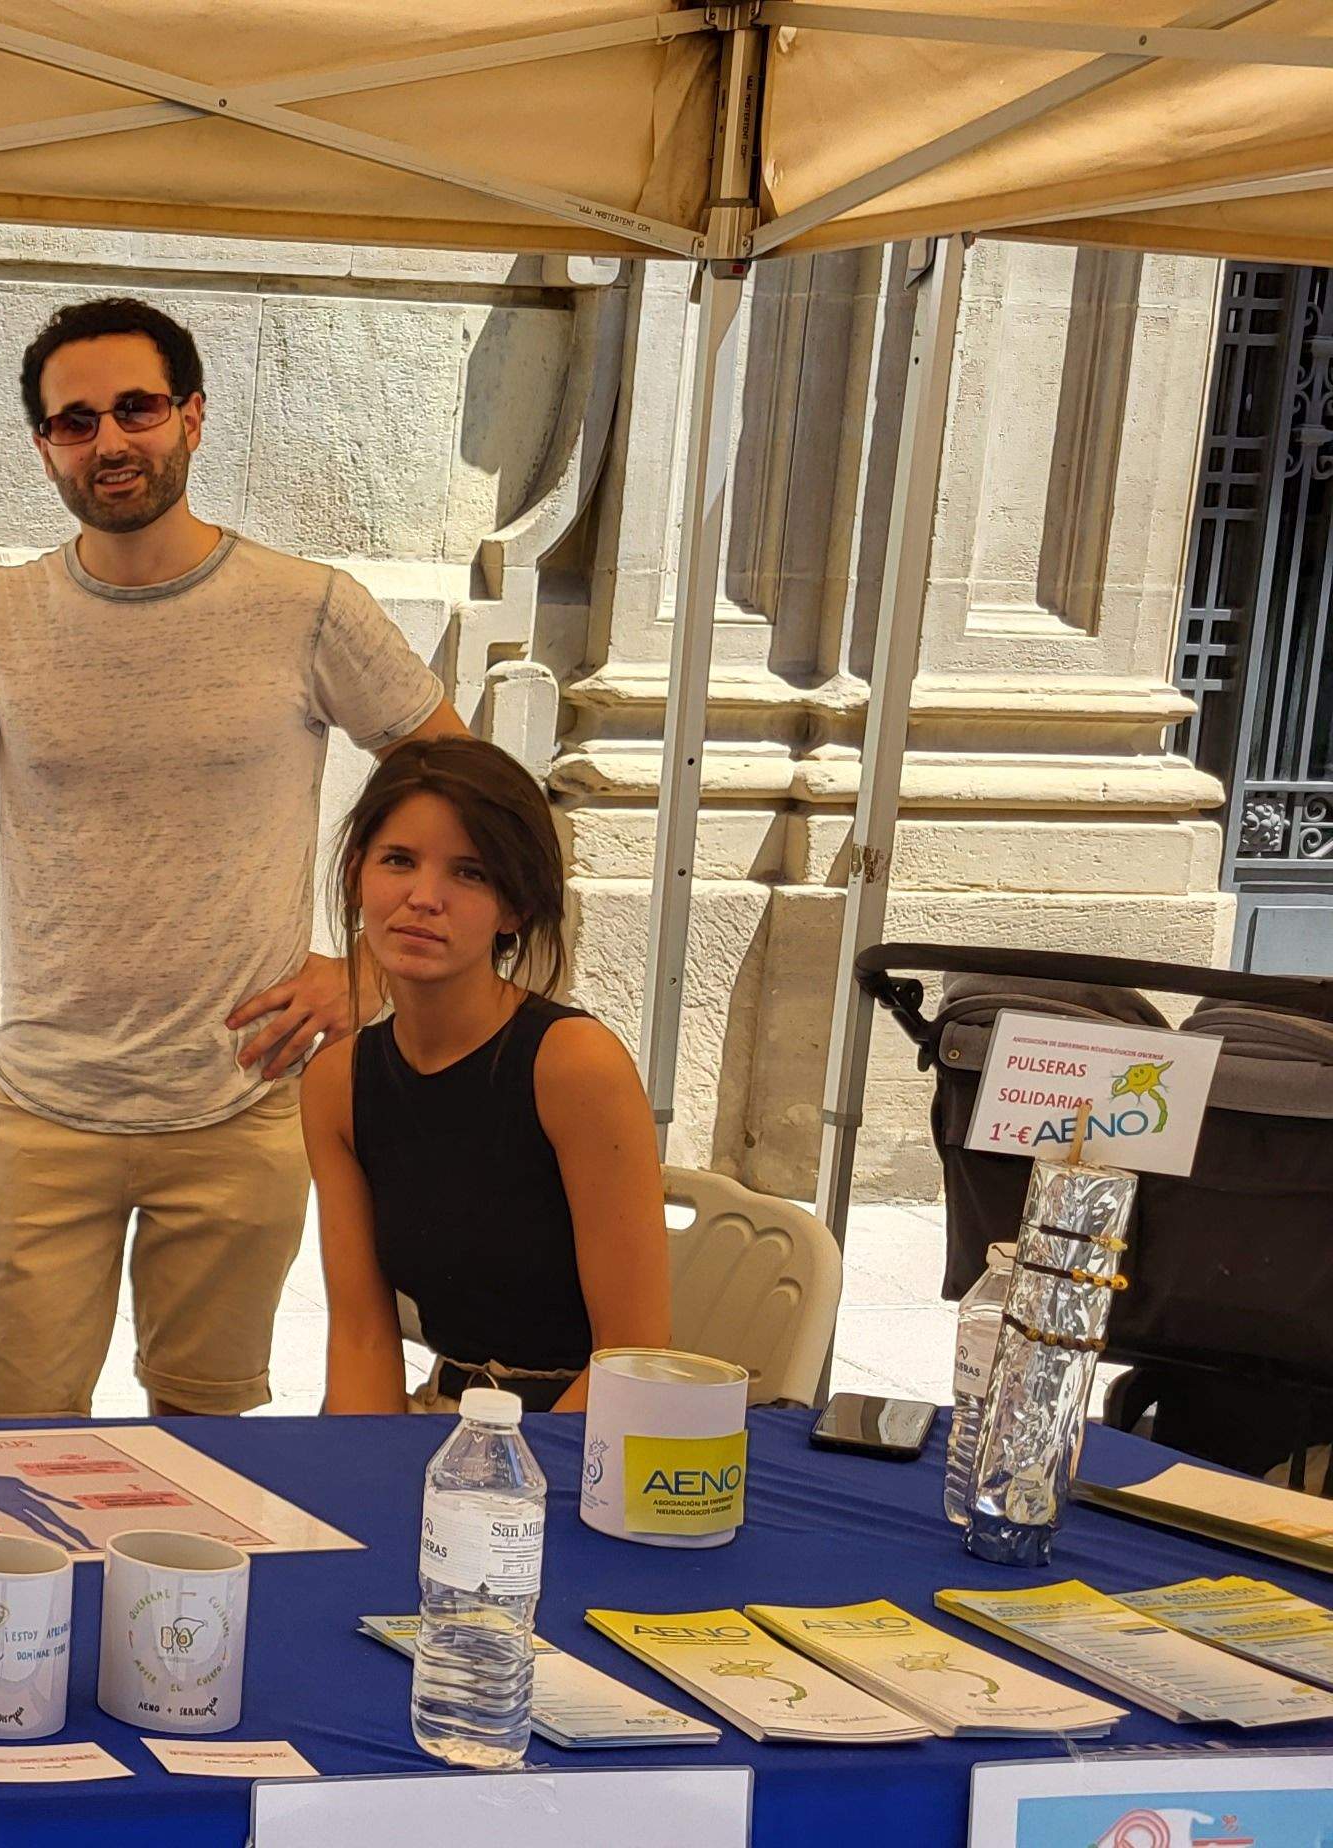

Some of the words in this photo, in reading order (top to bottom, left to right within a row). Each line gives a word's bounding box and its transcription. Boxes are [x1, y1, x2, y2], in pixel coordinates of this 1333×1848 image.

[1007, 1055, 1087, 1078] PULSERAS
[998, 1087, 1093, 1111] SOLIDARIAS
[642, 1464, 742, 1496] AENO
[653, 1498, 700, 1507] ASOCIACIÓN
[656, 1507, 710, 1516] NEUROLÓGICOS
[491, 1522, 519, 1537] San
[521, 1520, 543, 1537] Mill
[634, 1624, 751, 1638] AENO
[801, 1616, 911, 1631] AENO
[138, 1702, 160, 1713] AENO
